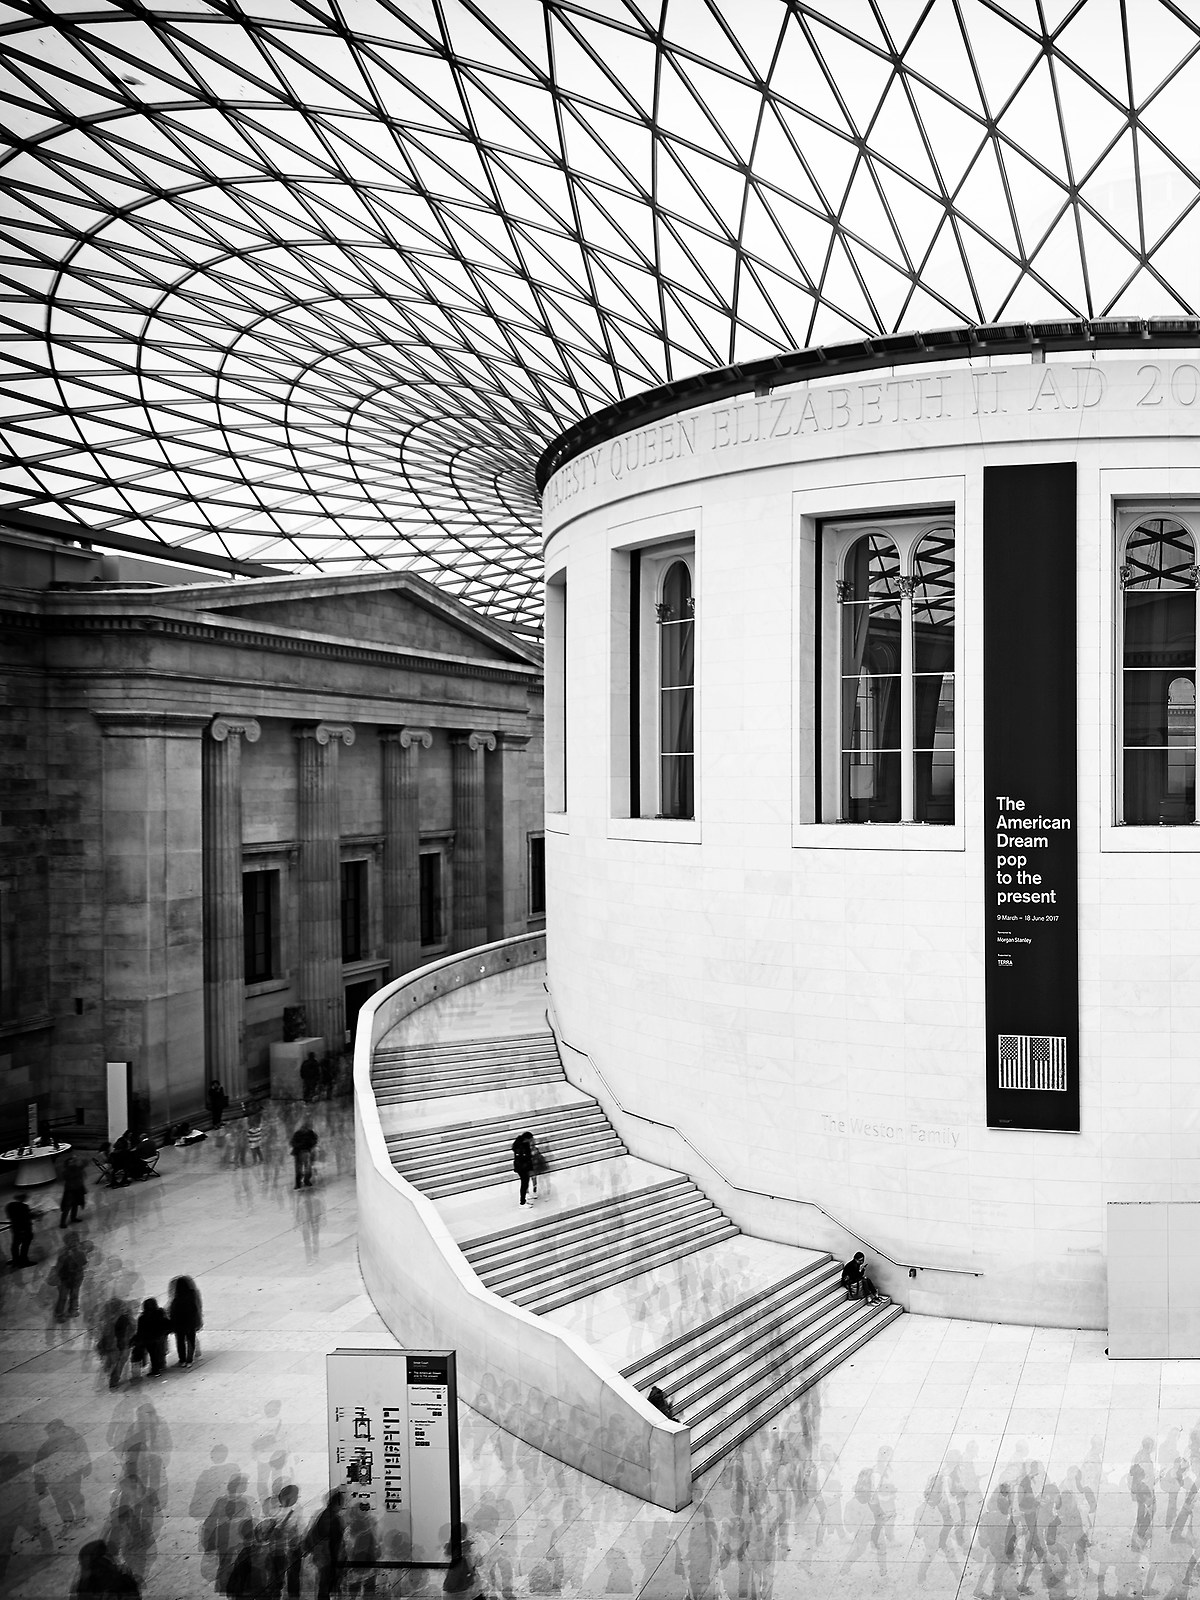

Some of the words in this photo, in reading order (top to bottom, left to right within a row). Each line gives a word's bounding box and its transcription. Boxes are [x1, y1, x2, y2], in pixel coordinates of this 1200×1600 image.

[609, 415, 699, 481] QUEEN
[711, 374, 952, 451] ELIZABETH
[971, 370, 1008, 416] II
[1027, 366, 1108, 411] AD
[996, 796, 1026, 811] The
[996, 815, 1071, 830] American
[997, 833, 1049, 848] Dream
[997, 854, 1027, 869] pop
[996, 871, 1012, 885] to
[1016, 871, 1042, 885] the
[997, 889, 1057, 906] present
[1024, 914, 1031, 922] 18
[821, 1113, 845, 1133] The
[849, 1117, 903, 1140] Weston
[910, 1123, 960, 1147] Family
